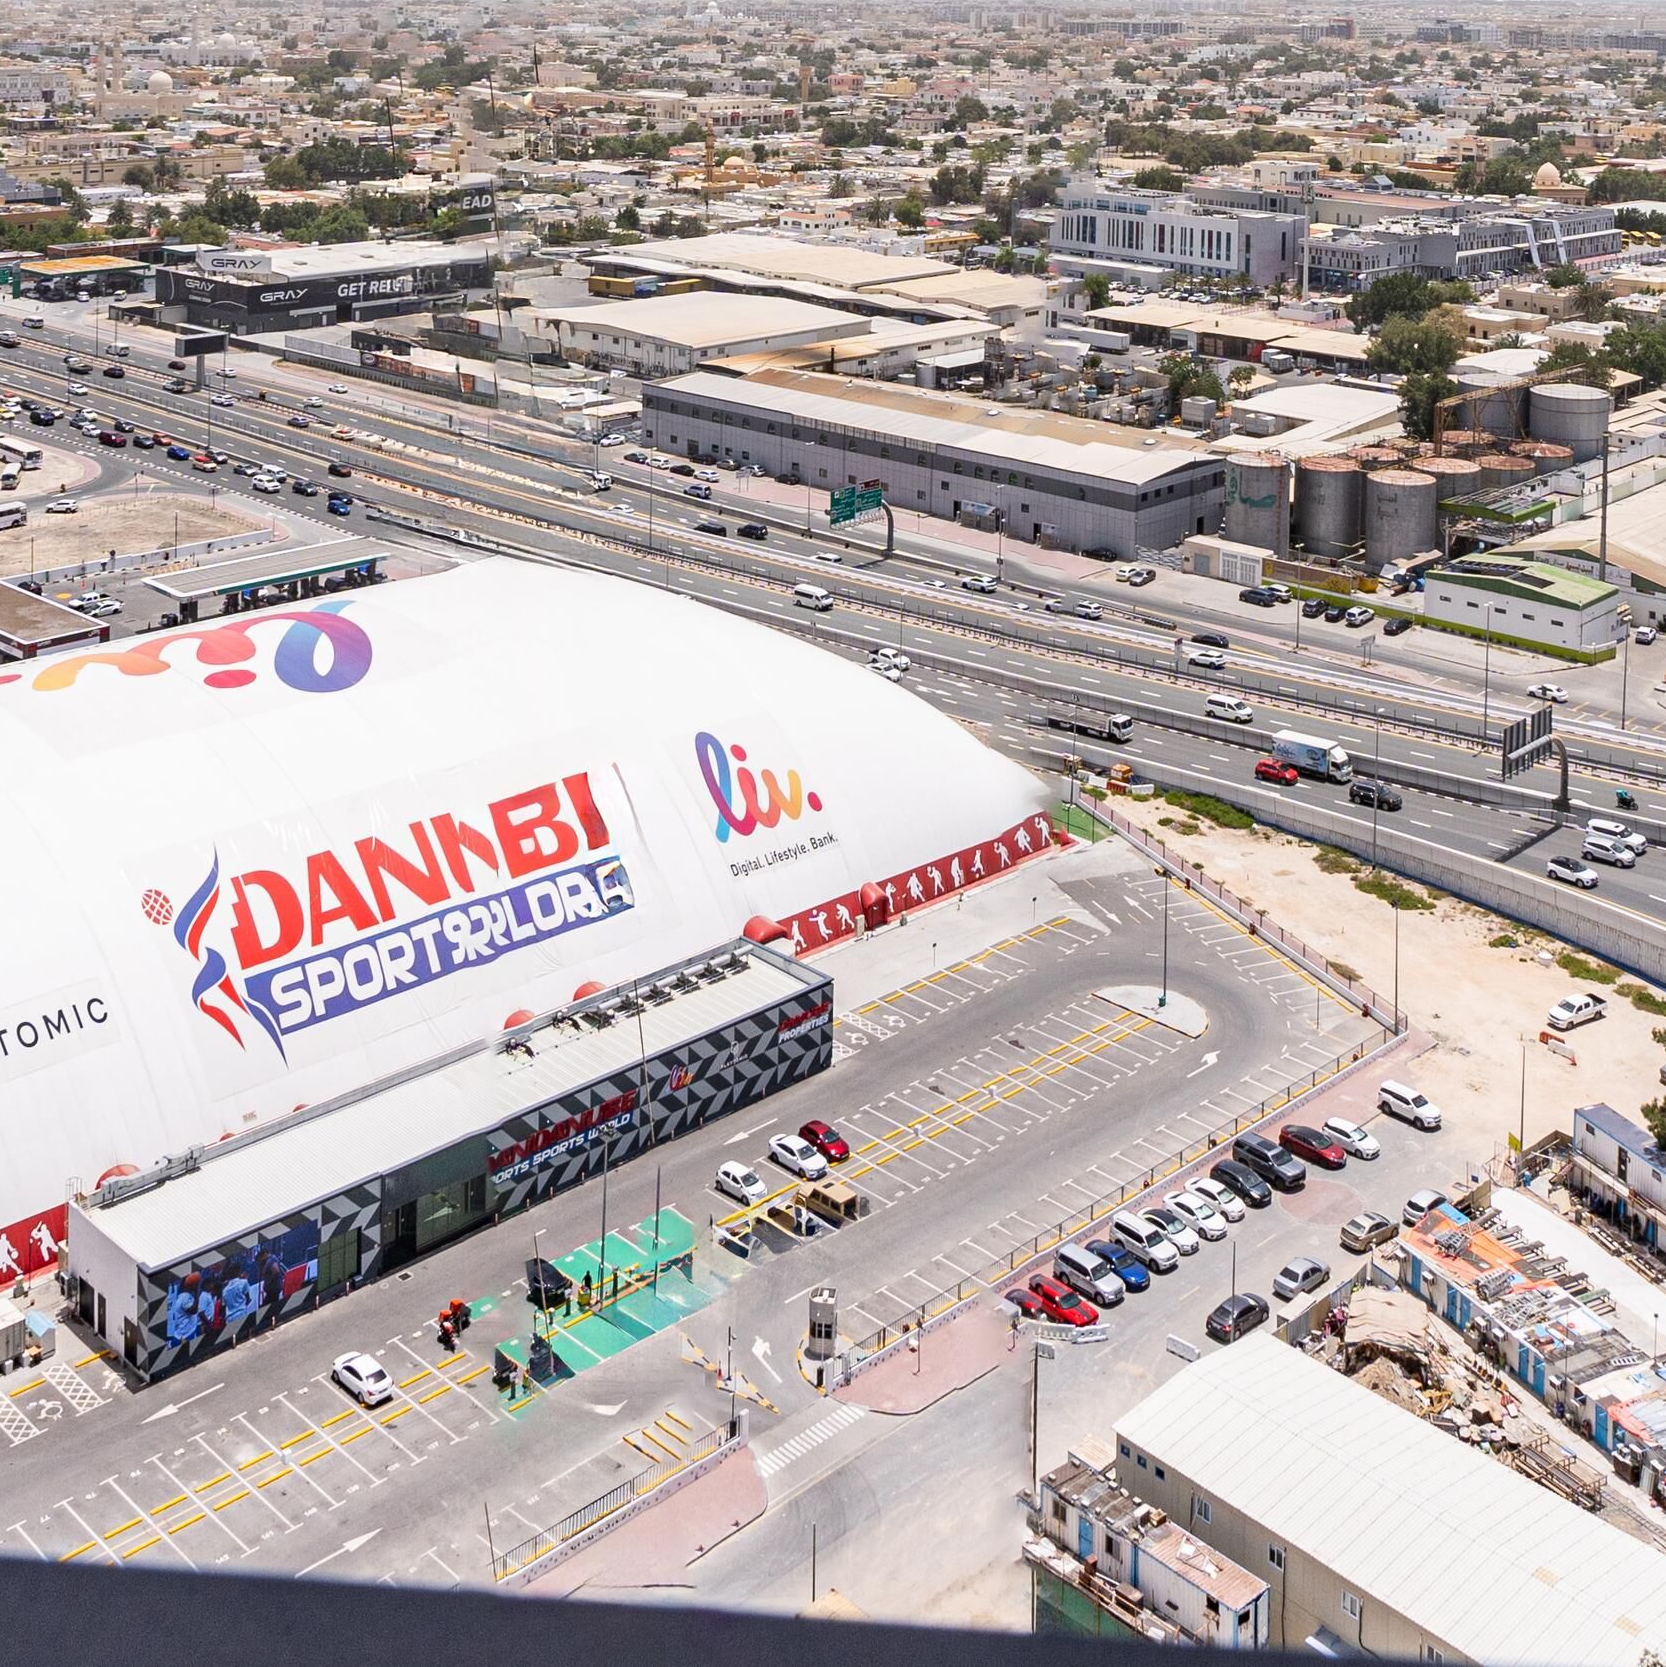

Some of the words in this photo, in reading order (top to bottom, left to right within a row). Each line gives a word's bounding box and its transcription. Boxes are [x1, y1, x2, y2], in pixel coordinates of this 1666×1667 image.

[211, 258, 262, 269] GRAY
[185, 278, 215, 292] GRAY
[337, 282, 368, 297] GET
[260, 288, 308, 303] GRAY
[730, 856, 765, 877] Digital.
[764, 842, 810, 866] Lifestyle.
[810, 832, 839, 850] Bank.
[779, 1014, 830, 1044] PROPERTIES
[533, 1136, 584, 1165] SPORTS
[588, 1113, 630, 1140] WRLD
